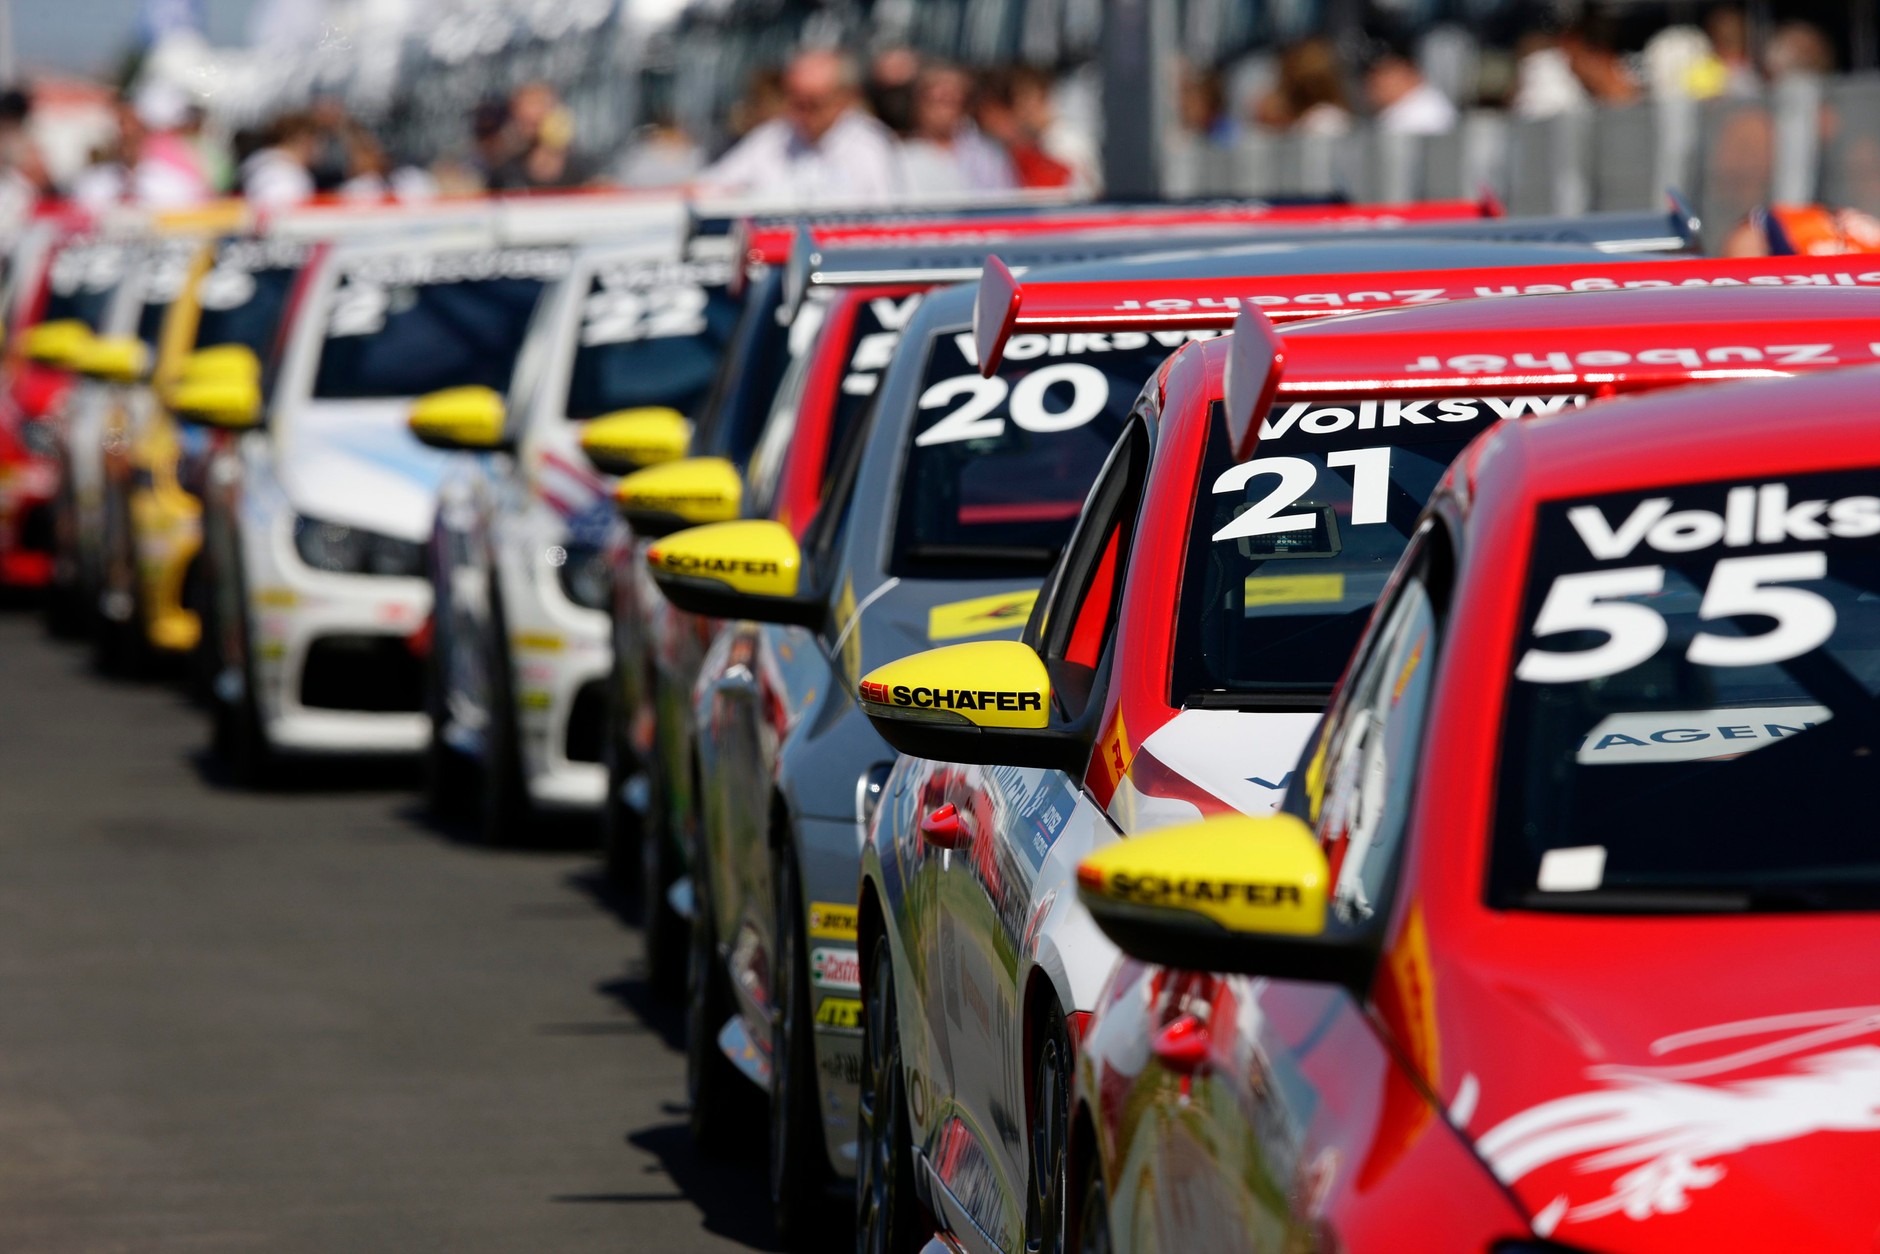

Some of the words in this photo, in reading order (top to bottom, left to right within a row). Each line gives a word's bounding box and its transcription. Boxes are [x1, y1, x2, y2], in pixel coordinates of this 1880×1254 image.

[1405, 343, 1839, 373] Zubehör
[914, 362, 1110, 448] 20
[1211, 446, 1392, 542] 21
[1565, 481, 1880, 561] Volks
[1513, 549, 1838, 684] 55
[892, 685, 1042, 712] SCHÄFER
